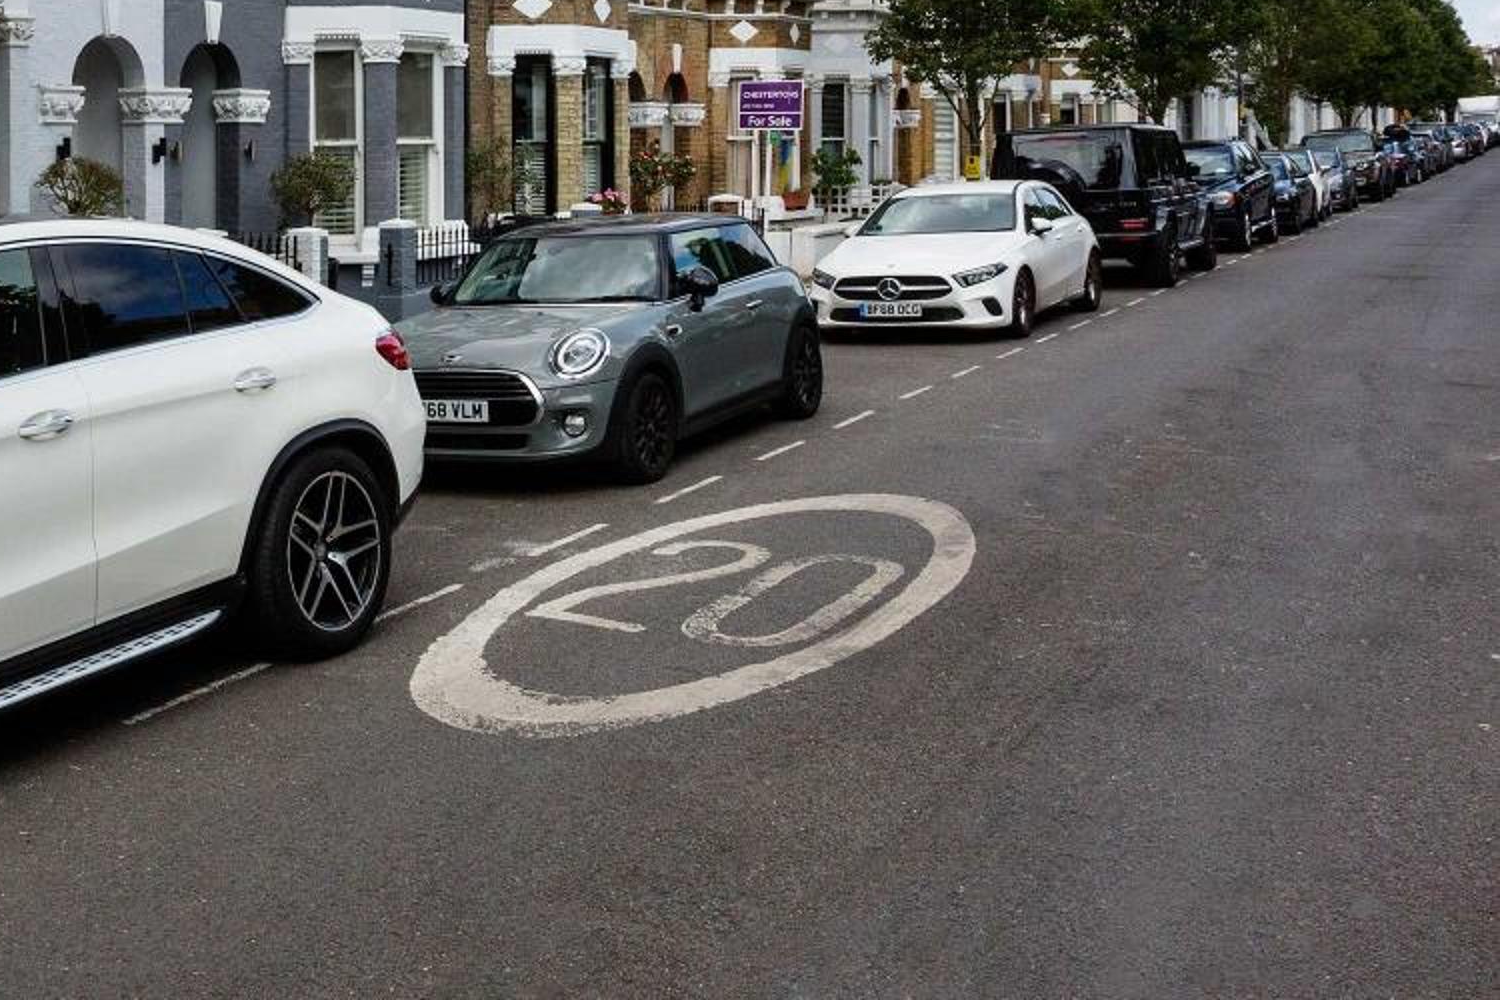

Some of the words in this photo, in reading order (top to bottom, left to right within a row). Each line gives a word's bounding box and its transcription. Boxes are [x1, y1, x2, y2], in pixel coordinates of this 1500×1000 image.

[747, 115, 766, 127] For
[767, 115, 793, 127] Sale
[451, 402, 483, 418] VLM
[525, 538, 906, 648] 20
